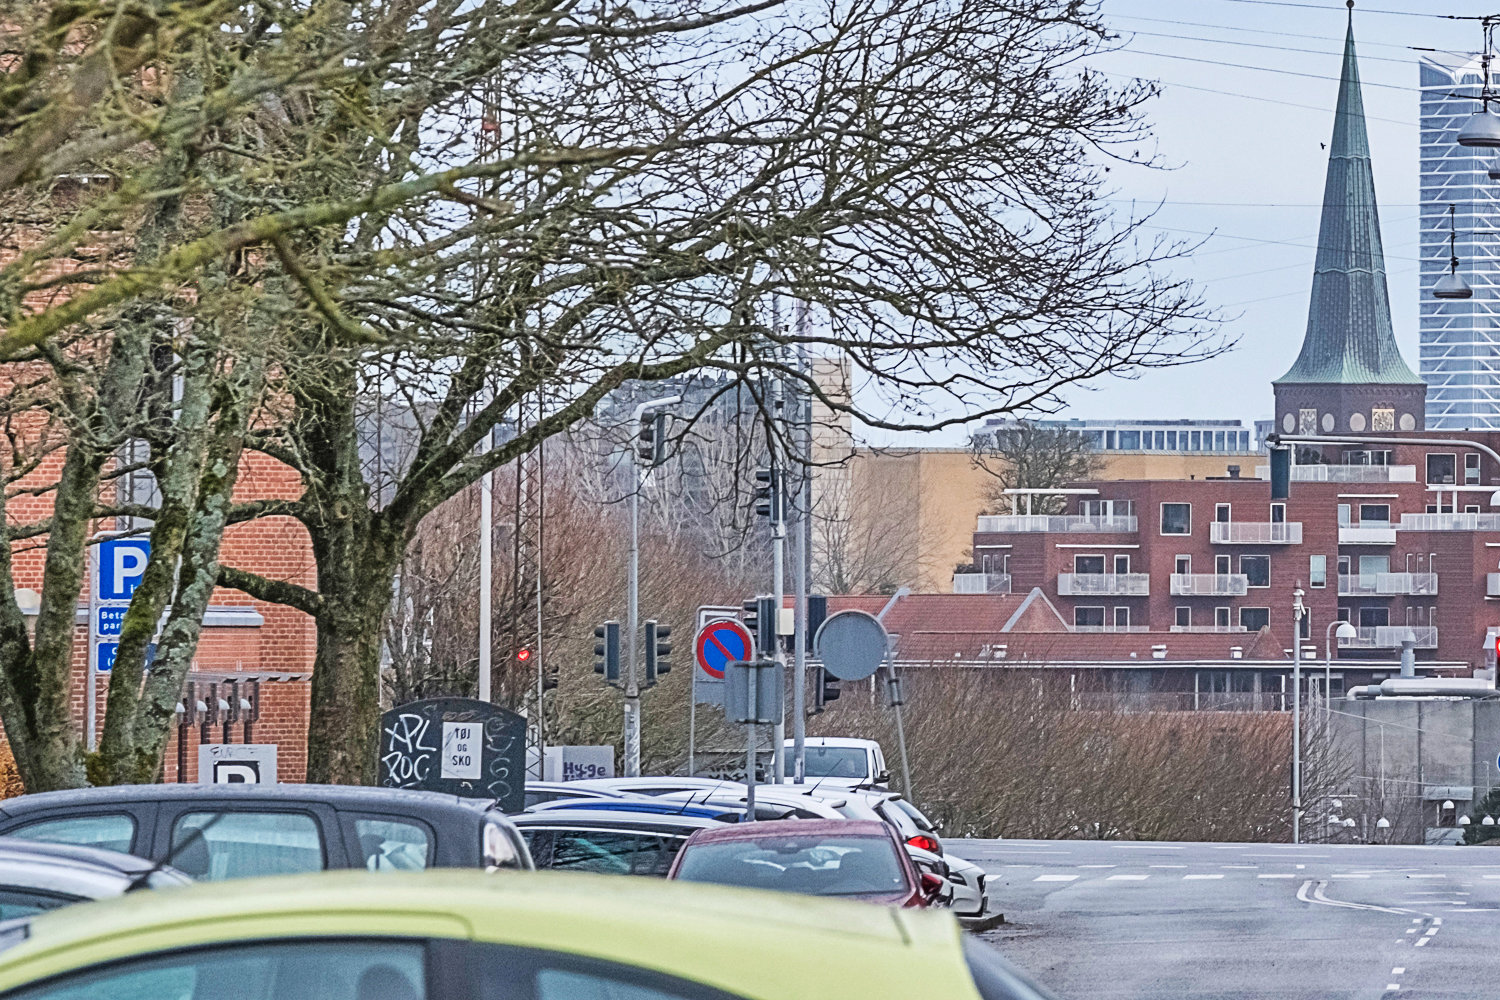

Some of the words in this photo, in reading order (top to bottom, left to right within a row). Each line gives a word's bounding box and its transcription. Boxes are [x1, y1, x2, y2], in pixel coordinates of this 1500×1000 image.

[113, 546, 148, 594] P
[455, 727, 471, 740] TØJ
[457, 744, 468, 752] OG
[452, 755, 471, 767] SKO
